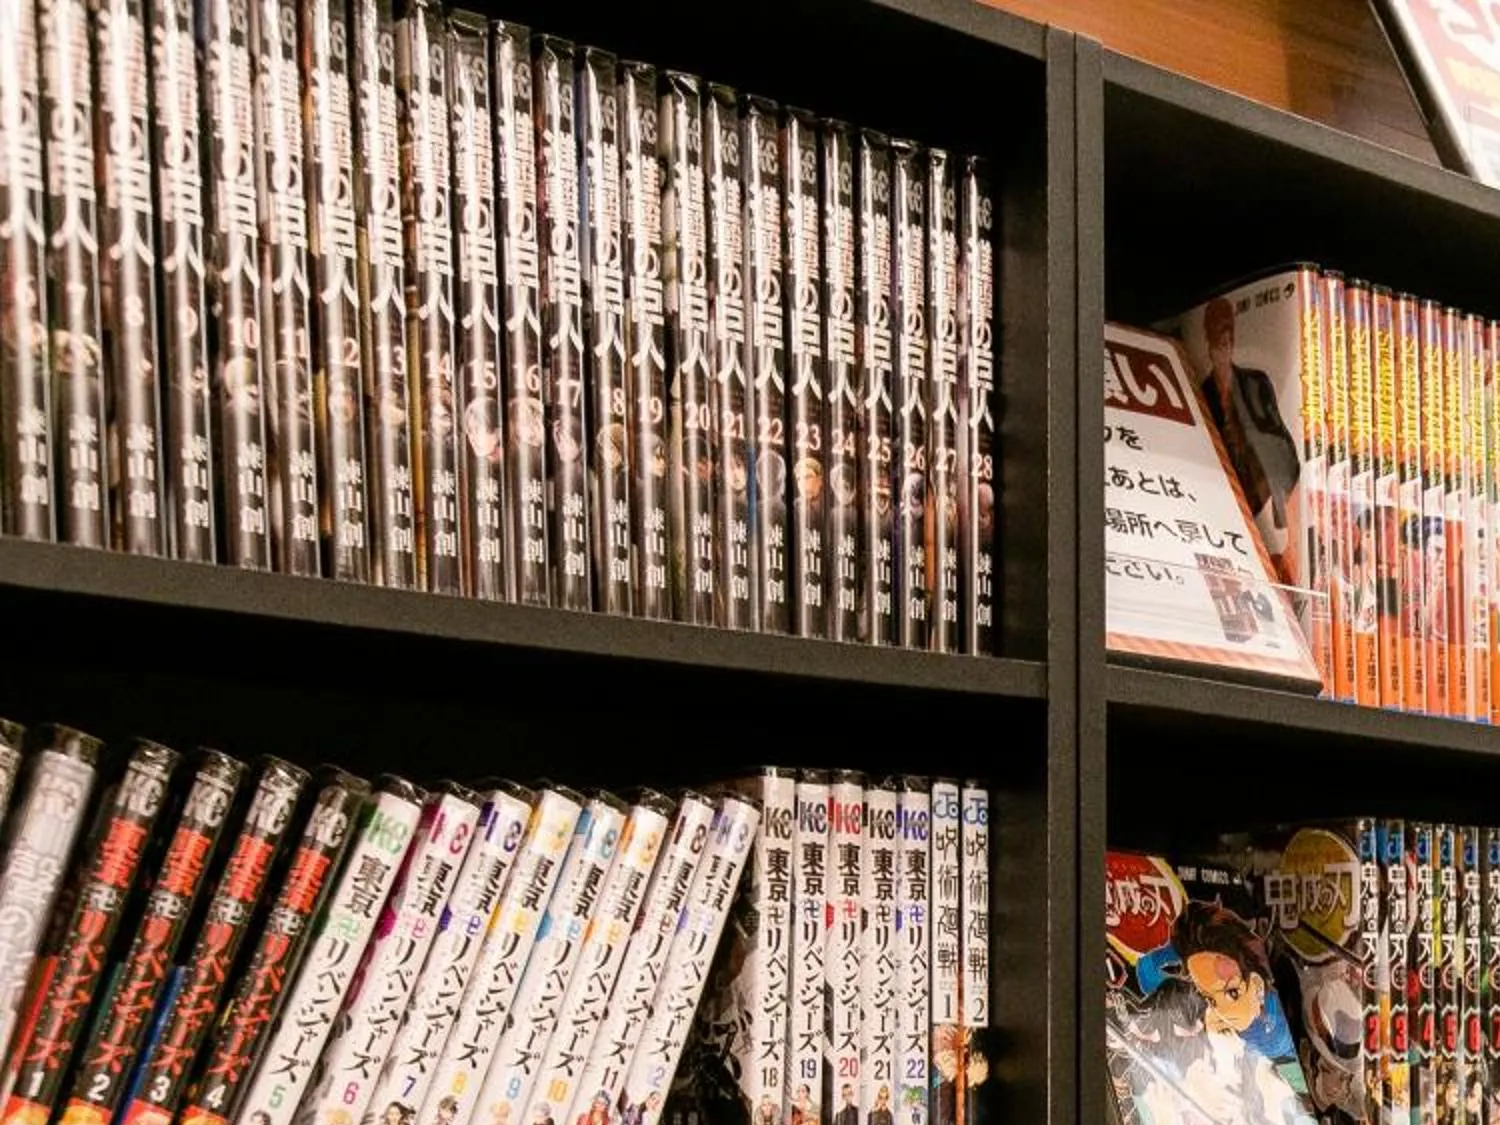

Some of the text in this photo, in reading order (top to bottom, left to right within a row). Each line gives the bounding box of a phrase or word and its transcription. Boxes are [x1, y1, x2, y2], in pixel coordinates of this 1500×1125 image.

[638, 397, 663, 423] 19
[684, 402, 710, 430] 20
[722, 410, 745, 438] 21
[757, 416, 784, 445] 22
[796, 422, 820, 450] 23
[832, 430, 855, 457] 24
[868, 435, 891, 462] 25
[902, 445, 925, 470] 26
[935, 446, 957, 473] 27
[972, 453, 993, 479] 28
[943, 995, 951, 1018] 1
[971, 997, 985, 1022] 2
[601, 1066, 618, 1091] 11
[800, 1058, 818, 1079] 19
[839, 1057, 859, 1078] 20
[874, 1060, 892, 1081] 21
[907, 1059, 925, 1079] 22
[28, 1071, 44, 1096] 1
[88, 1074, 110, 1101] 2
[151, 1075, 171, 1102] 3
[343, 1081, 360, 1105] 6
[401, 1075, 416, 1098] 7
[507, 1076, 521, 1100] 9
[207, 1084, 226, 1109] 4
[268, 1085, 287, 1109] 5
